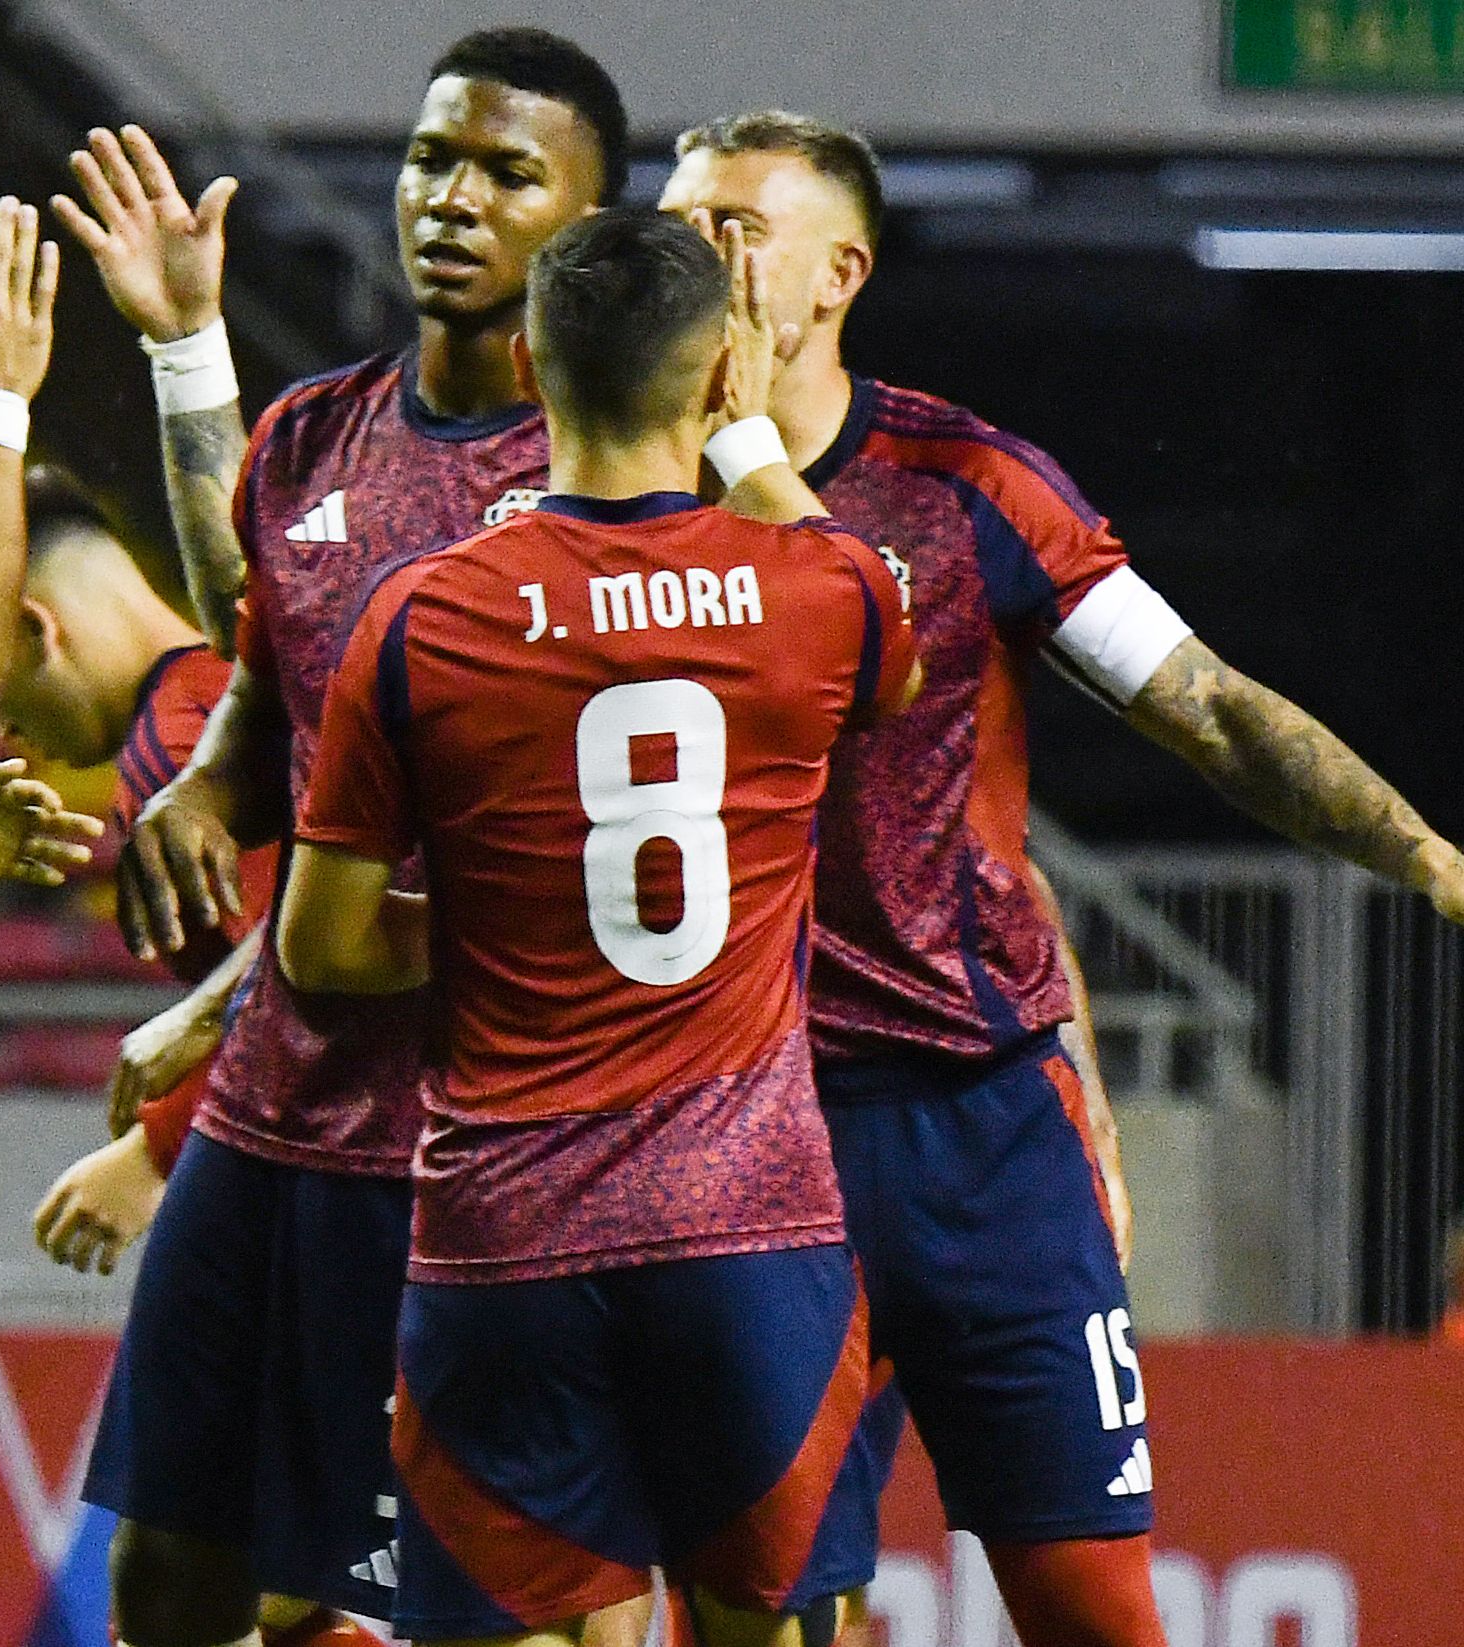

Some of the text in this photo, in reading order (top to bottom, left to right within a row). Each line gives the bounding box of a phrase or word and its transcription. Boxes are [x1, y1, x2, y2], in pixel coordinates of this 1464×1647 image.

[518, 565, 764, 643] J. MORA
[576, 678, 731, 986] 8
[1084, 1307, 1147, 1430] 15
